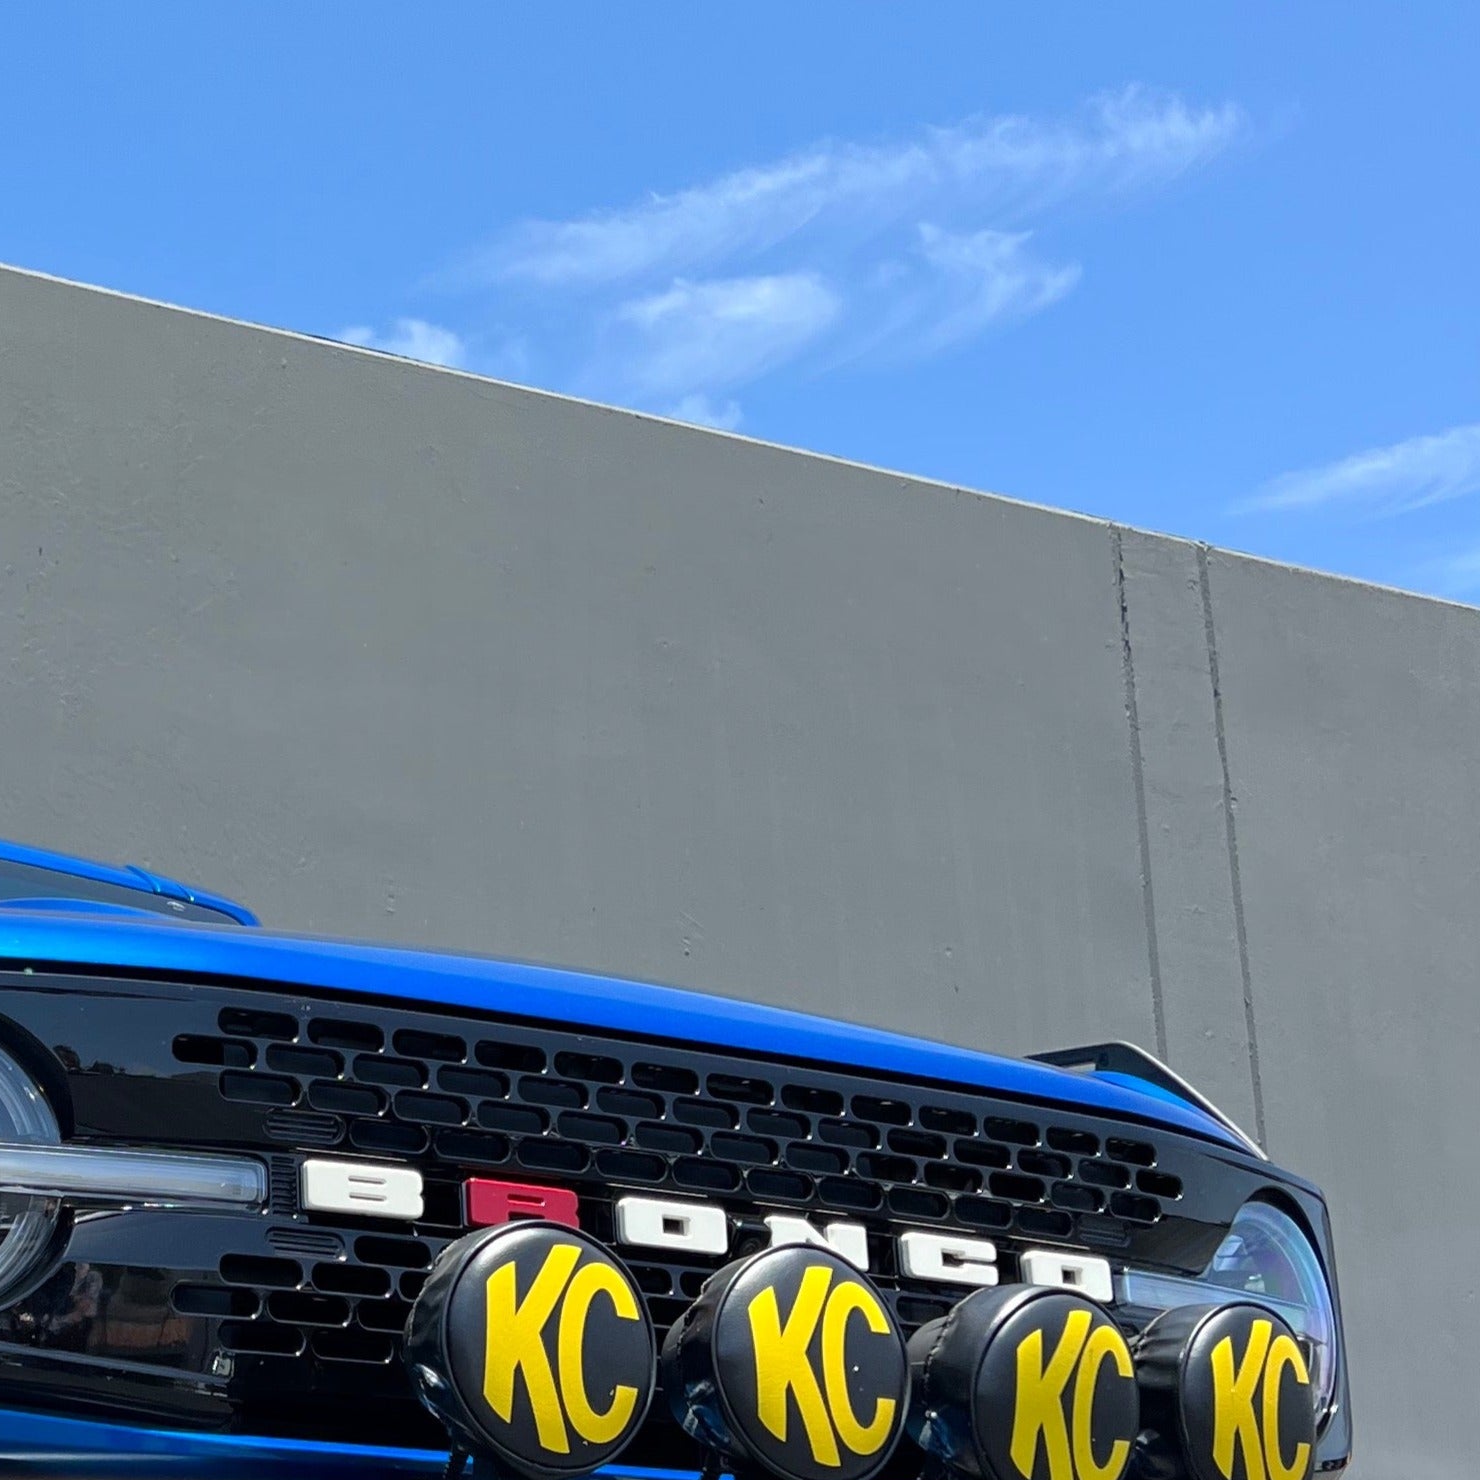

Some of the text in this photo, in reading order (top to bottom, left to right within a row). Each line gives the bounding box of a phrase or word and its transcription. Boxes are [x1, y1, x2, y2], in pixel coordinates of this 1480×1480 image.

[302, 1157, 1114, 1303] BRONCO
[482, 1243, 640, 1454] KC
[747, 1265, 897, 1467] KC
